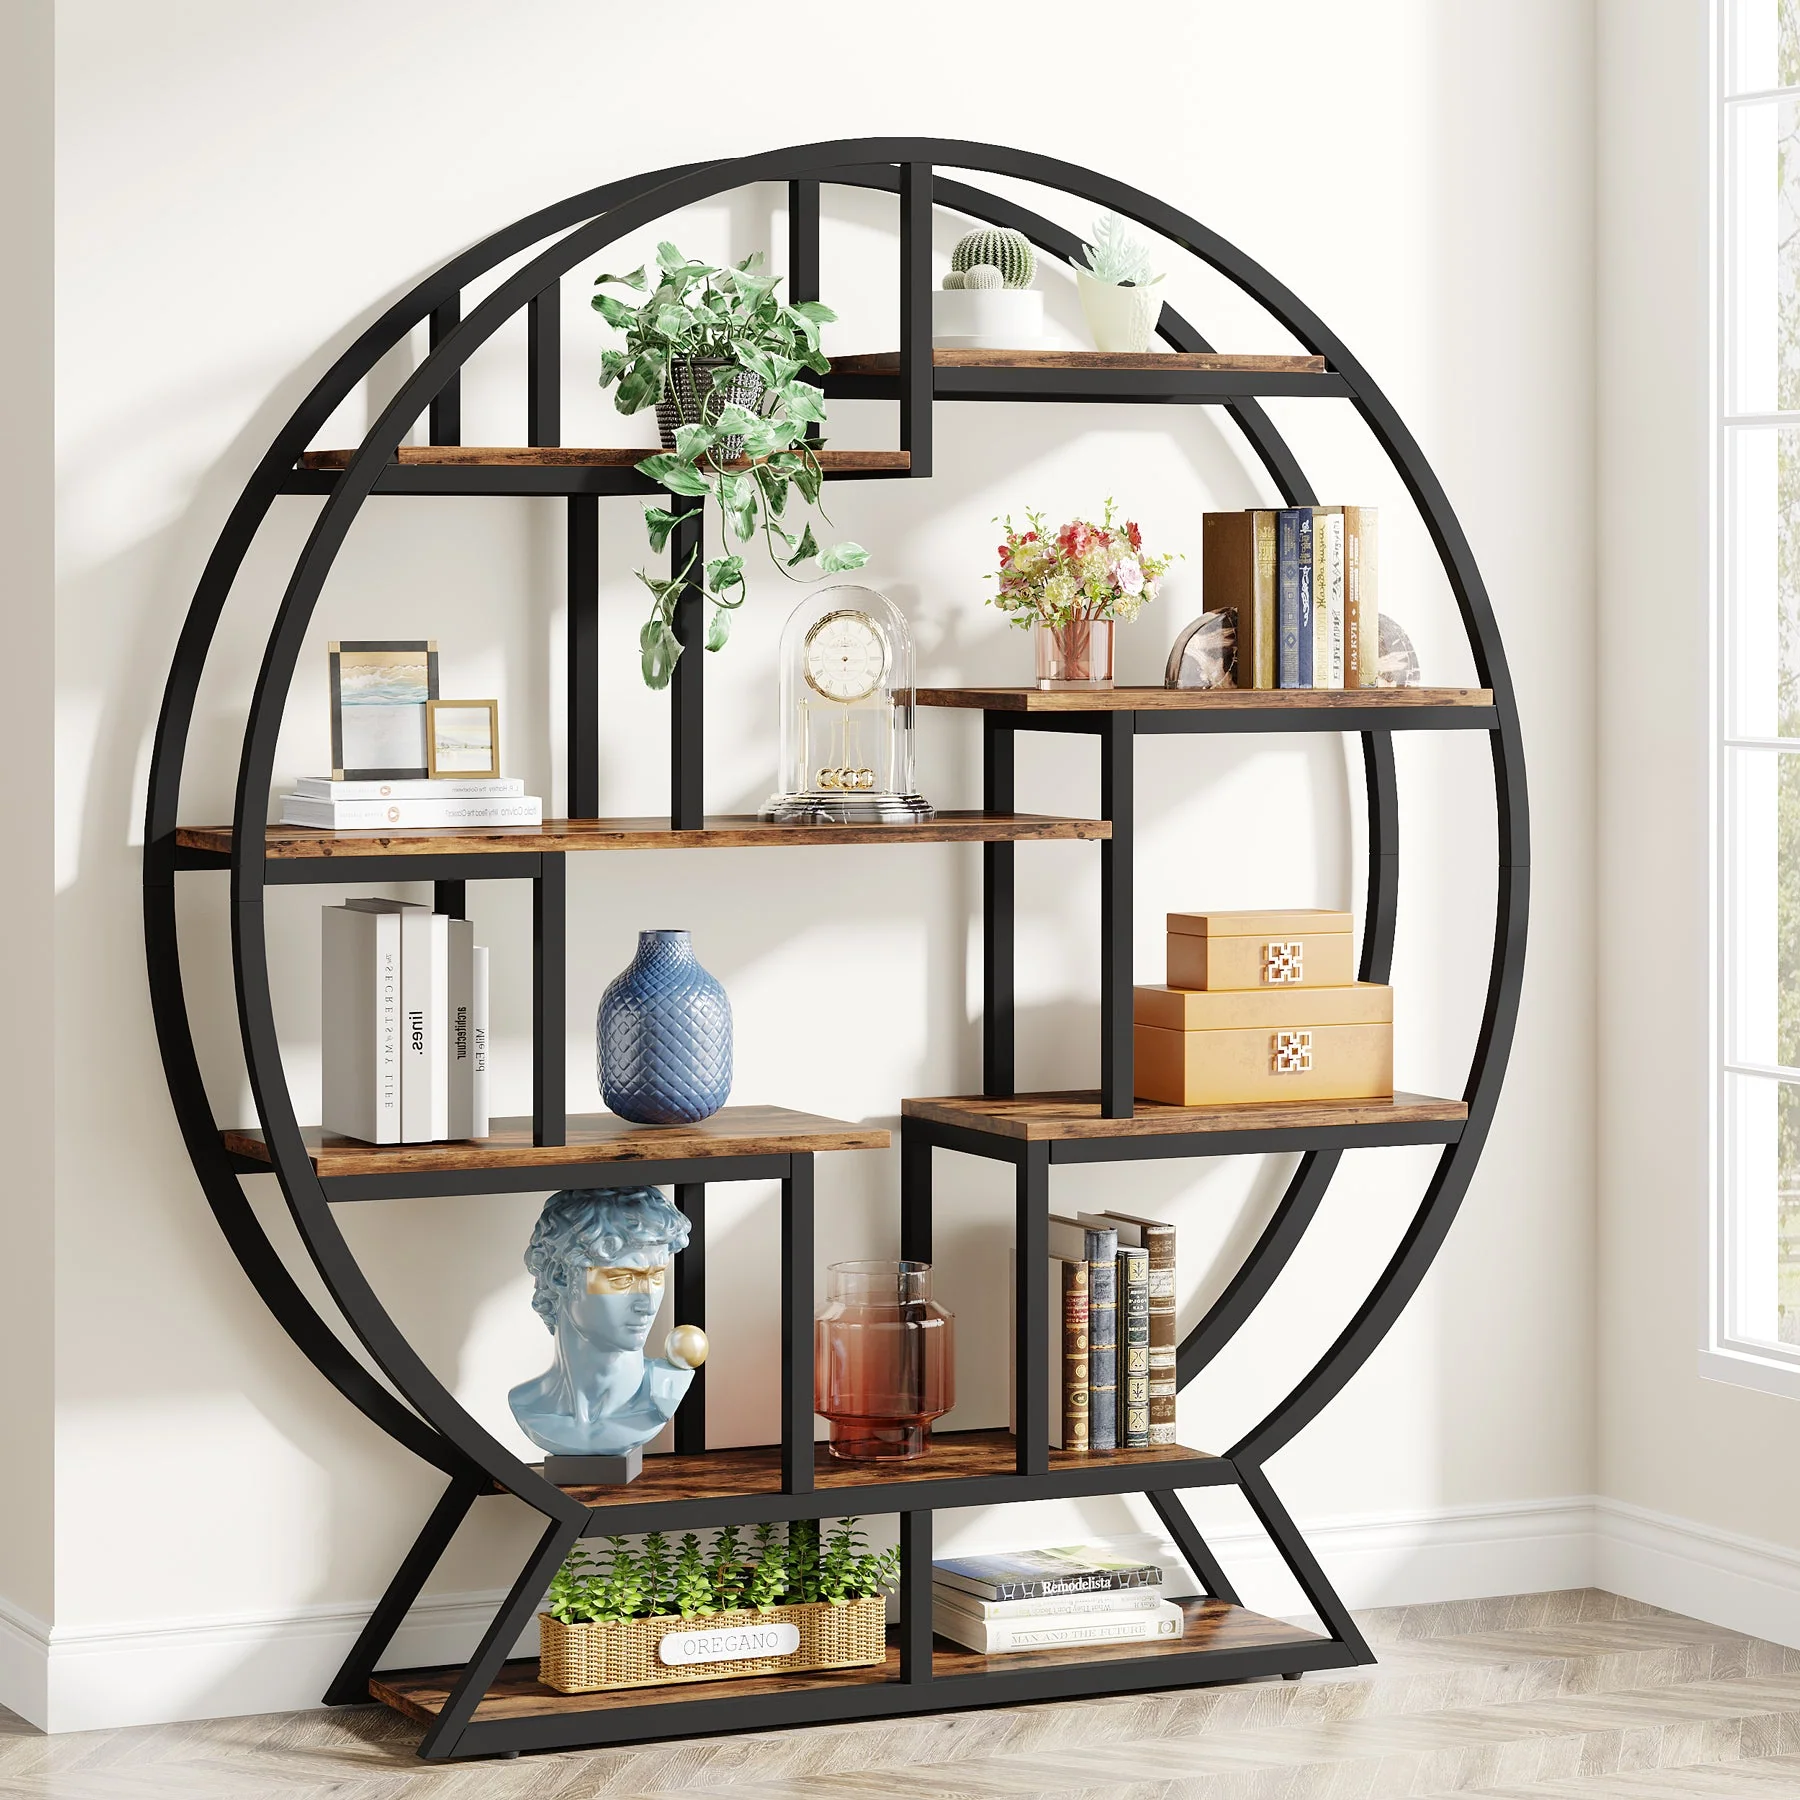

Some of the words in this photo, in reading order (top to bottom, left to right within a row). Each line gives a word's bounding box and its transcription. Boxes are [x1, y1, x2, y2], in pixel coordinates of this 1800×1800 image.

[1042, 1576, 1112, 1595] Remodelista
[683, 1631, 778, 1656] OREGANO
[1011, 1634, 1038, 1645] MAN
[1044, 1632, 1068, 1642] AND
[1072, 1629, 1098, 1639] THE
[1101, 1625, 1147, 1637] FUTURE
